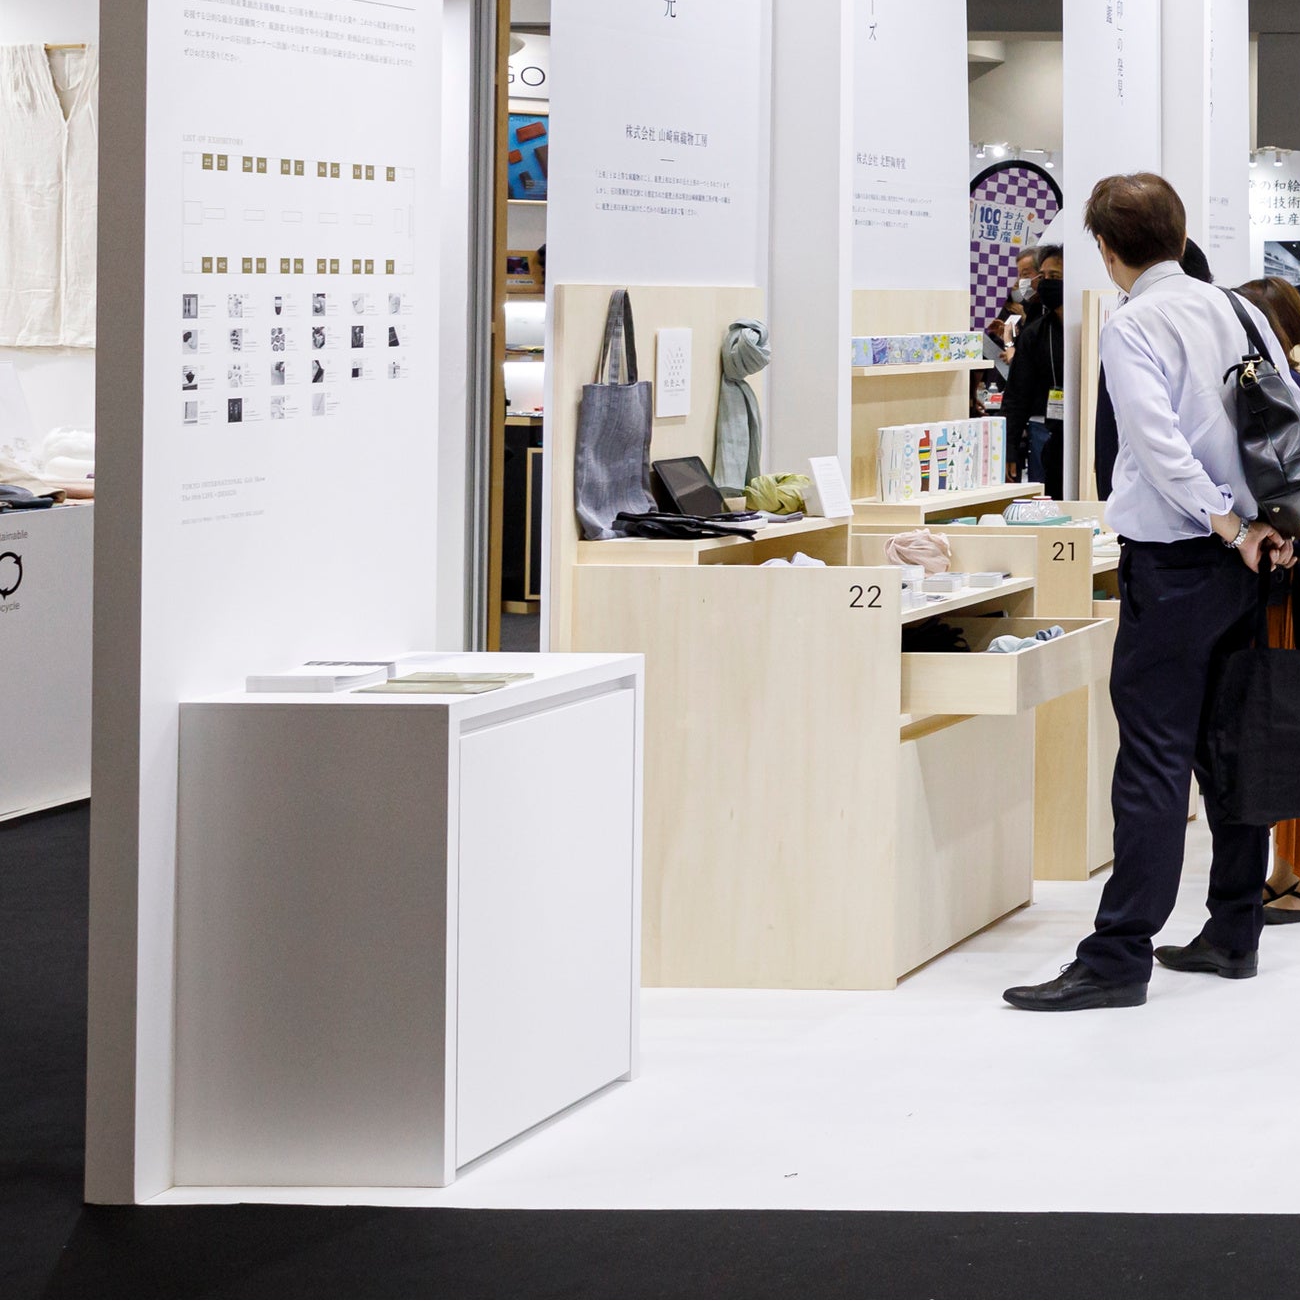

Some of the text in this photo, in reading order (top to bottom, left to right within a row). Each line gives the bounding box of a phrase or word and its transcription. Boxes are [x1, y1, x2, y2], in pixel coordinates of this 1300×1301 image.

[1000, 210, 1014, 244] お土産
[1052, 541, 1075, 562] 21
[849, 584, 883, 609] 22
